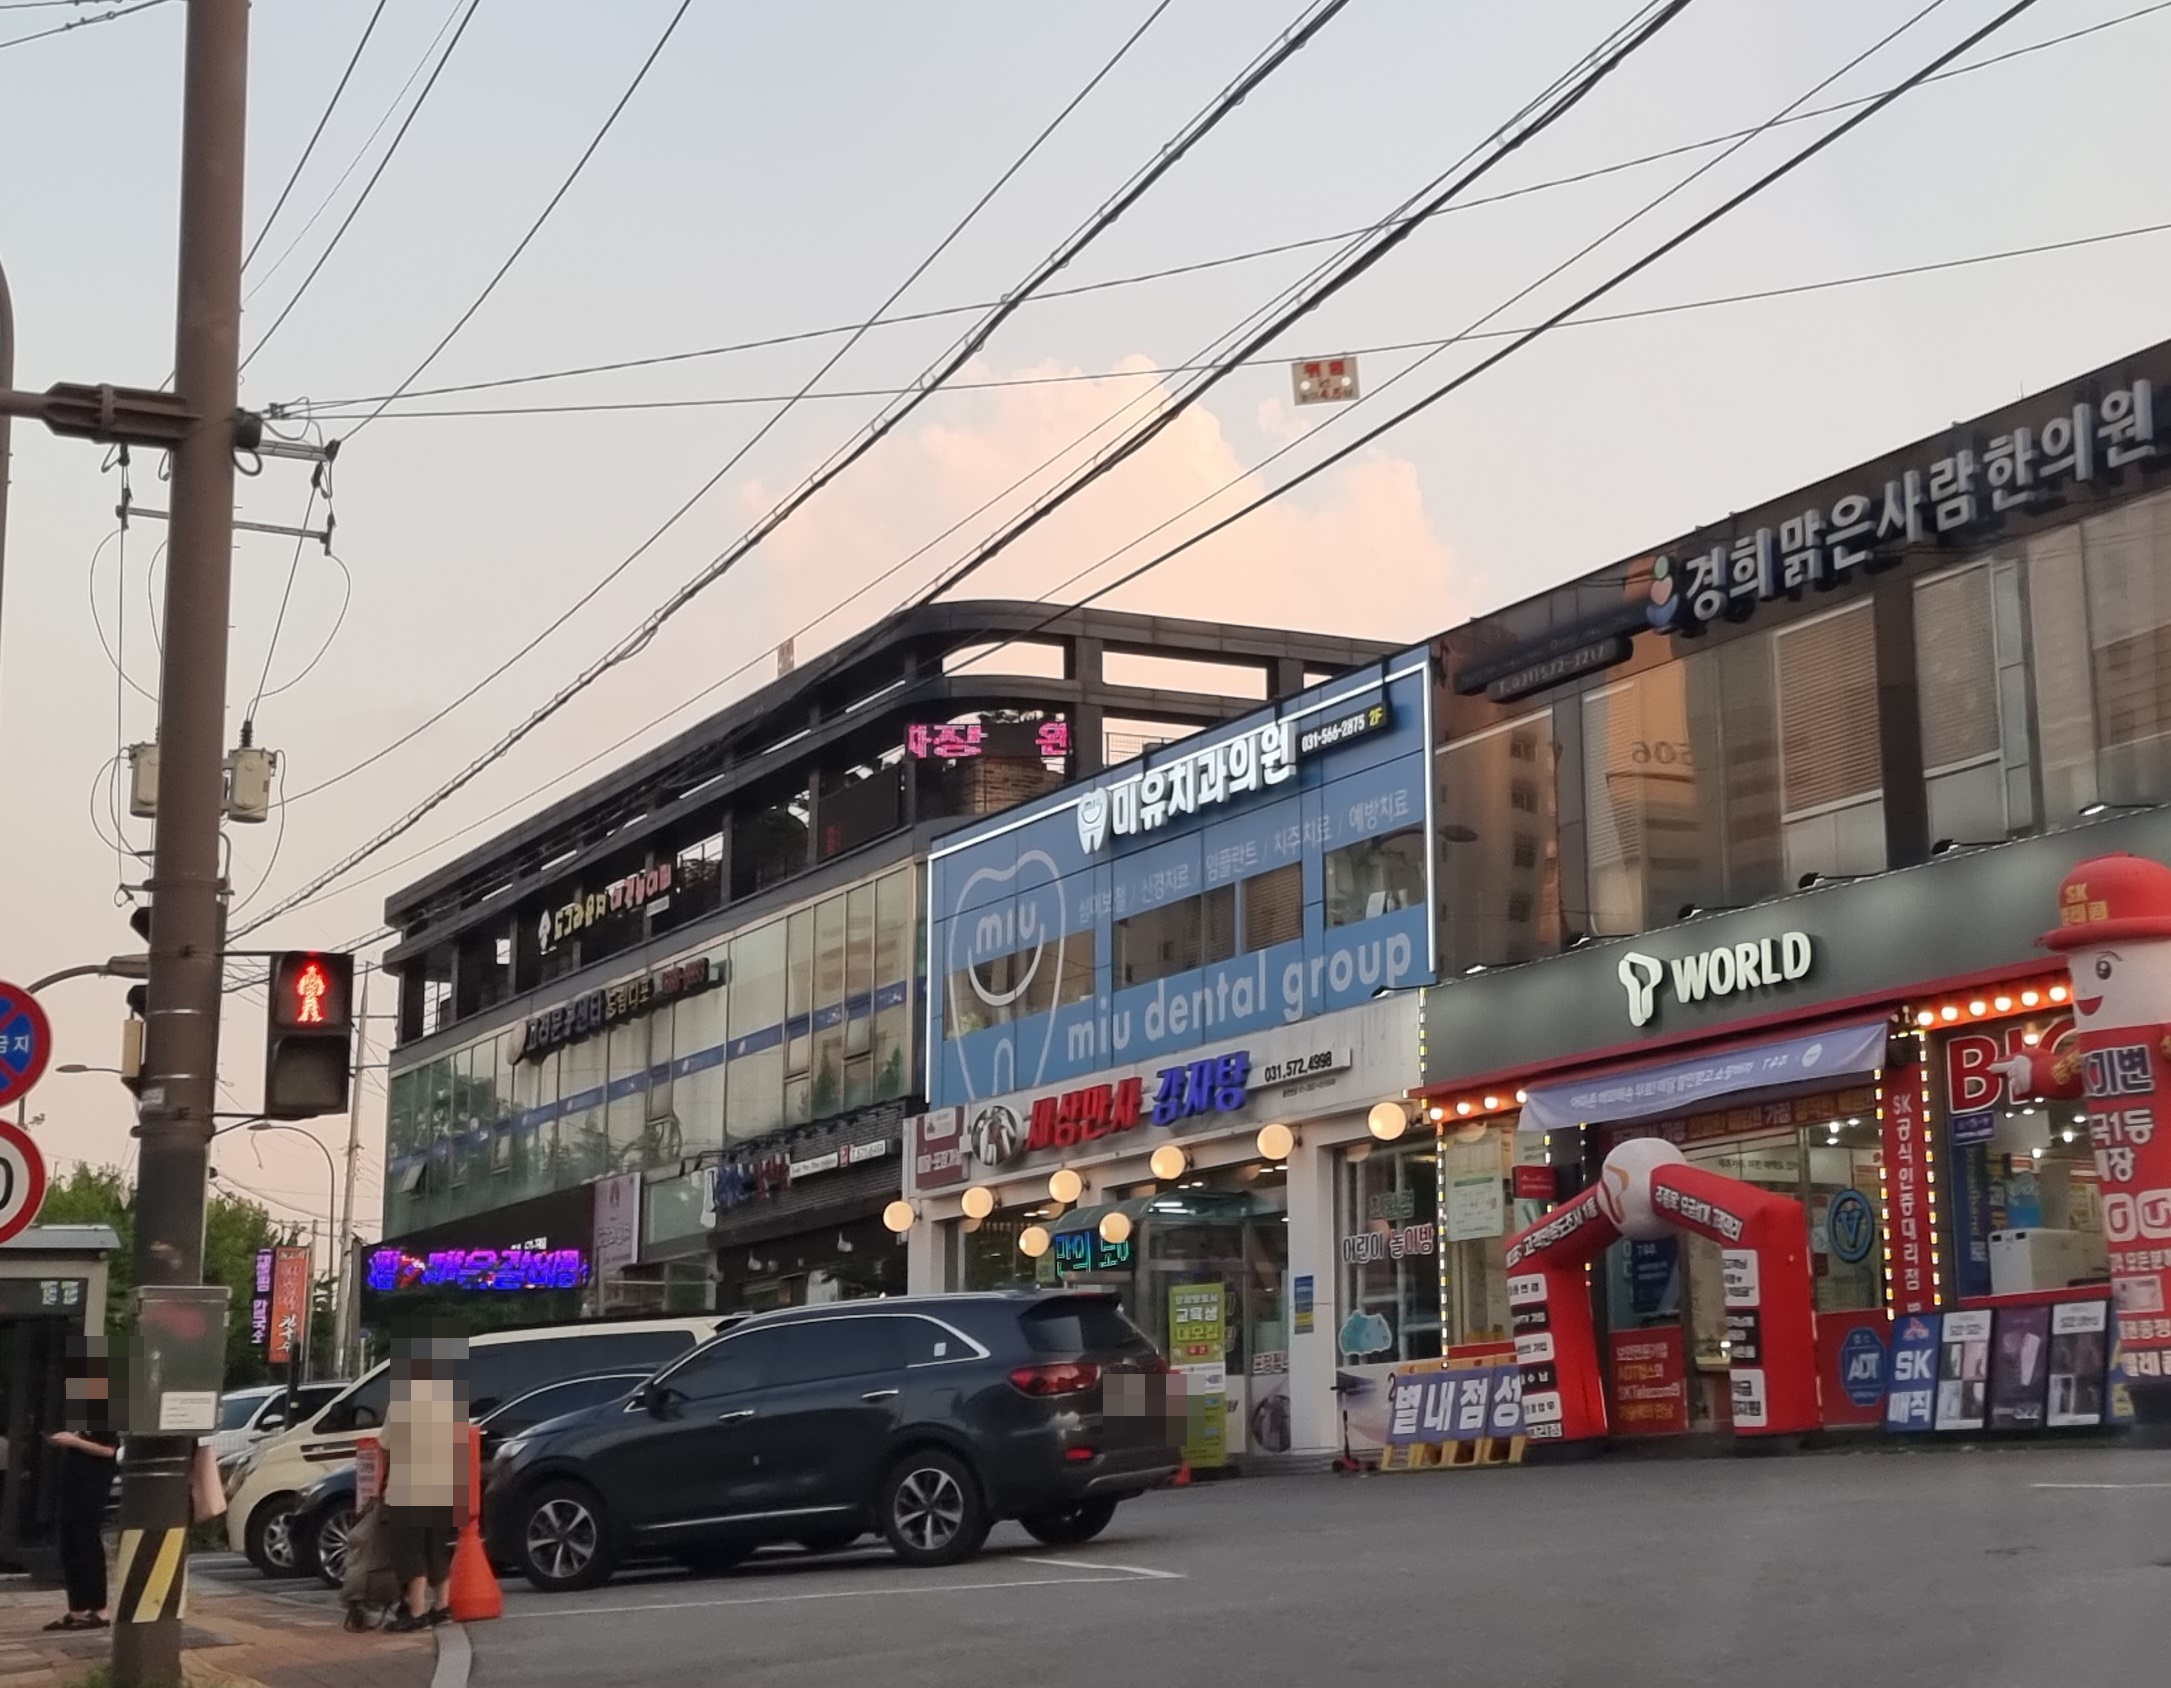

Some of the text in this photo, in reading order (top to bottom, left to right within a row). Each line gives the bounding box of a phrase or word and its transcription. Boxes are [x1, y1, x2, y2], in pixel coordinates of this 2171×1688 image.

[1686, 378, 2156, 620] 경희맑은사람한의원
[1112, 720, 1297, 837] 미유치과의원
[1368, 706, 1384, 727] 2F
[1141, 863, 1190, 904] 신경치료
[1206, 840, 1258, 882] 임플란트
[1349, 789, 1409, 833] 예방치료
[976, 901, 1036, 954] miu
[1670, 931, 1812, 1003] WORLD
[1068, 932, 1412, 1062] miu dental group
[1025, 1076, 1144, 1151] 세상만사
[1151, 1051, 1252, 1127] 감자탕
[1343, 1223, 1434, 1264] 어린이 놀이방
[1848, 1353, 1879, 1381] ADT
[1895, 1348, 1934, 1381] SK
